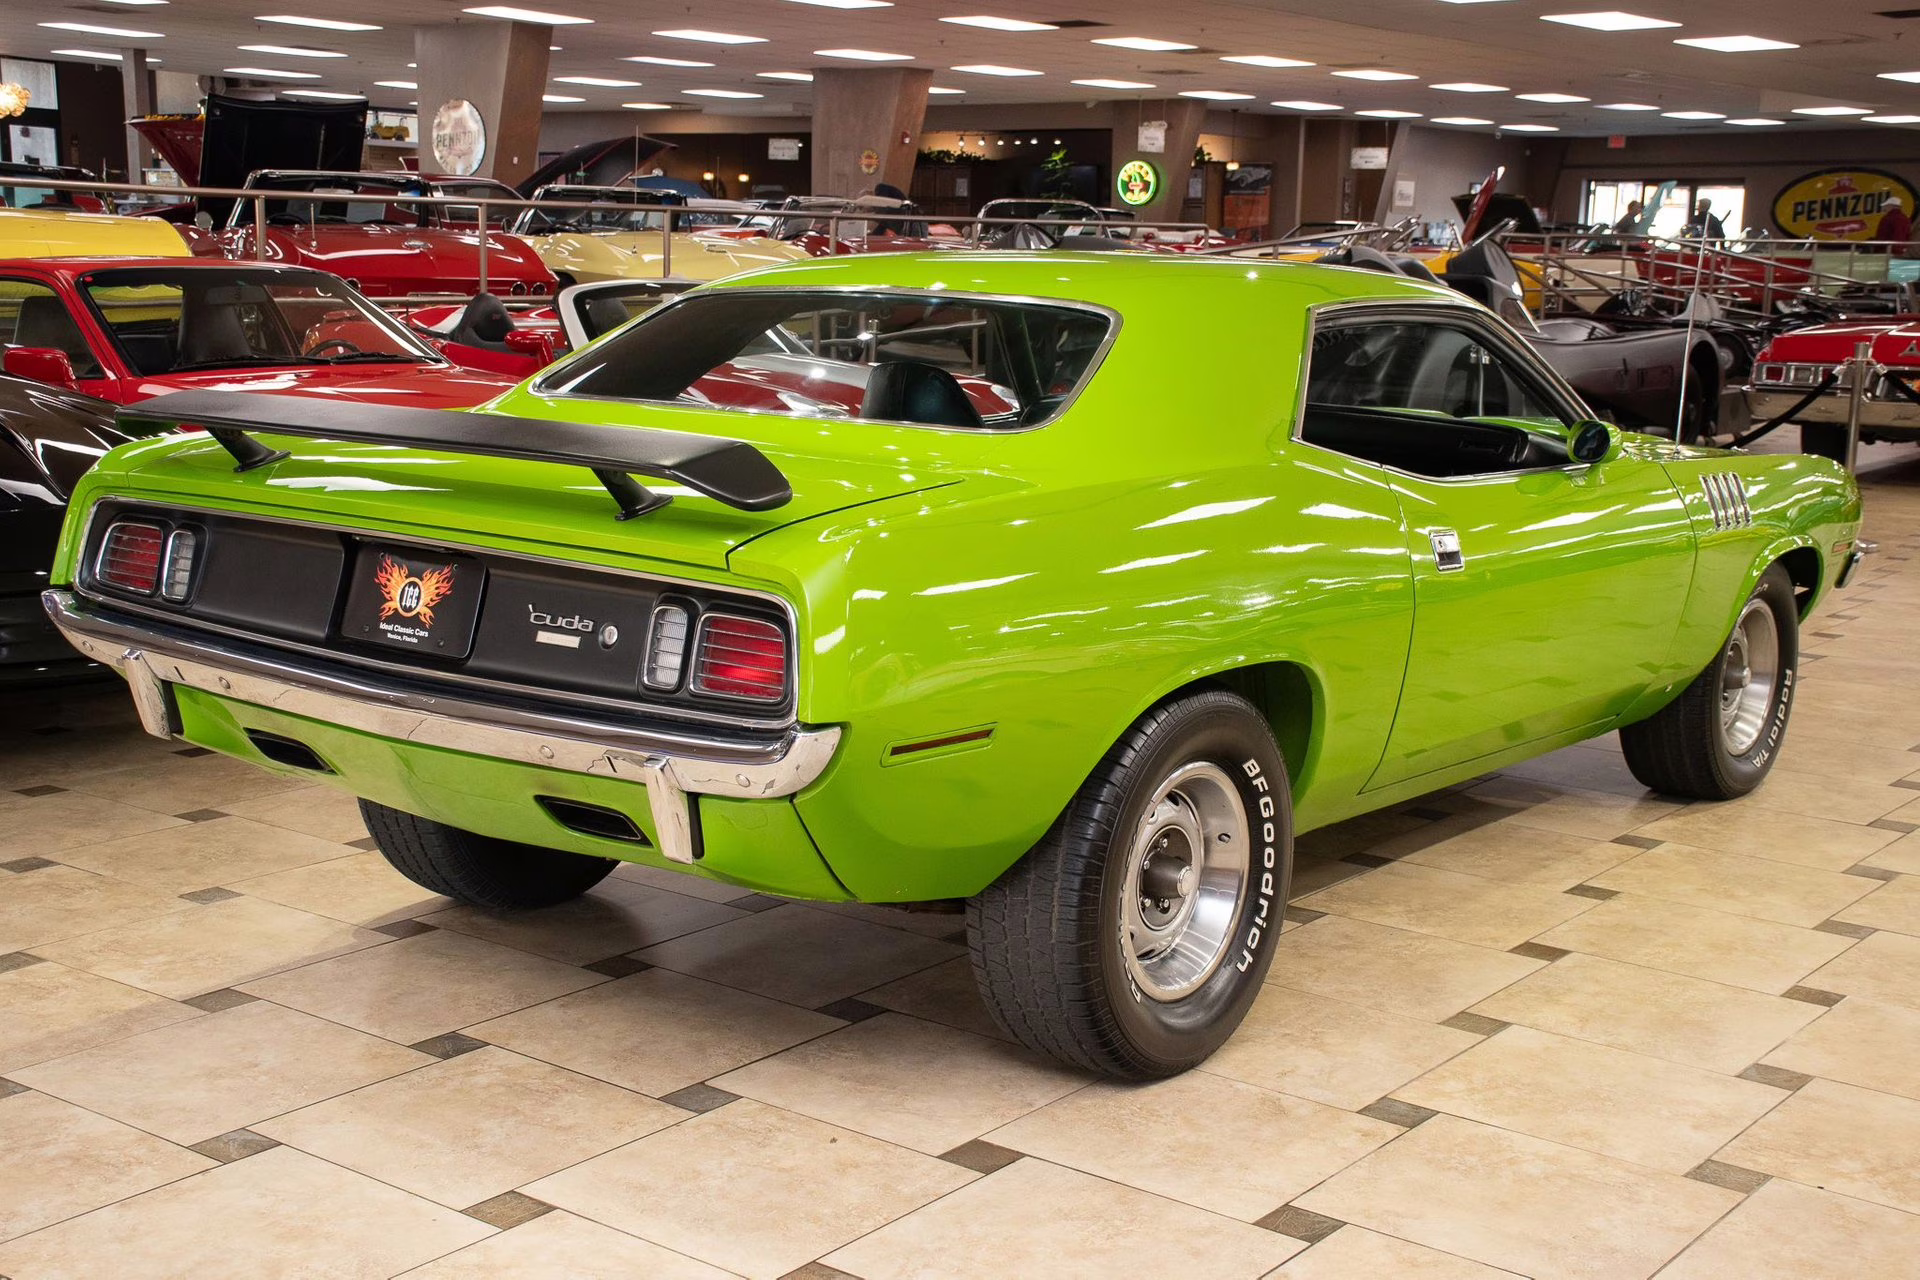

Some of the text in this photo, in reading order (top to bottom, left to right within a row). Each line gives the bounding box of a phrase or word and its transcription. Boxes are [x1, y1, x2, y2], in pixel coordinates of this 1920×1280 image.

[379, 622, 429, 637] Ideal Classic Cars
[402, 635, 418, 643] Florida
[1751, 668, 1793, 768] Radial T/A
[1235, 758, 1274, 974] BFGoodrich
